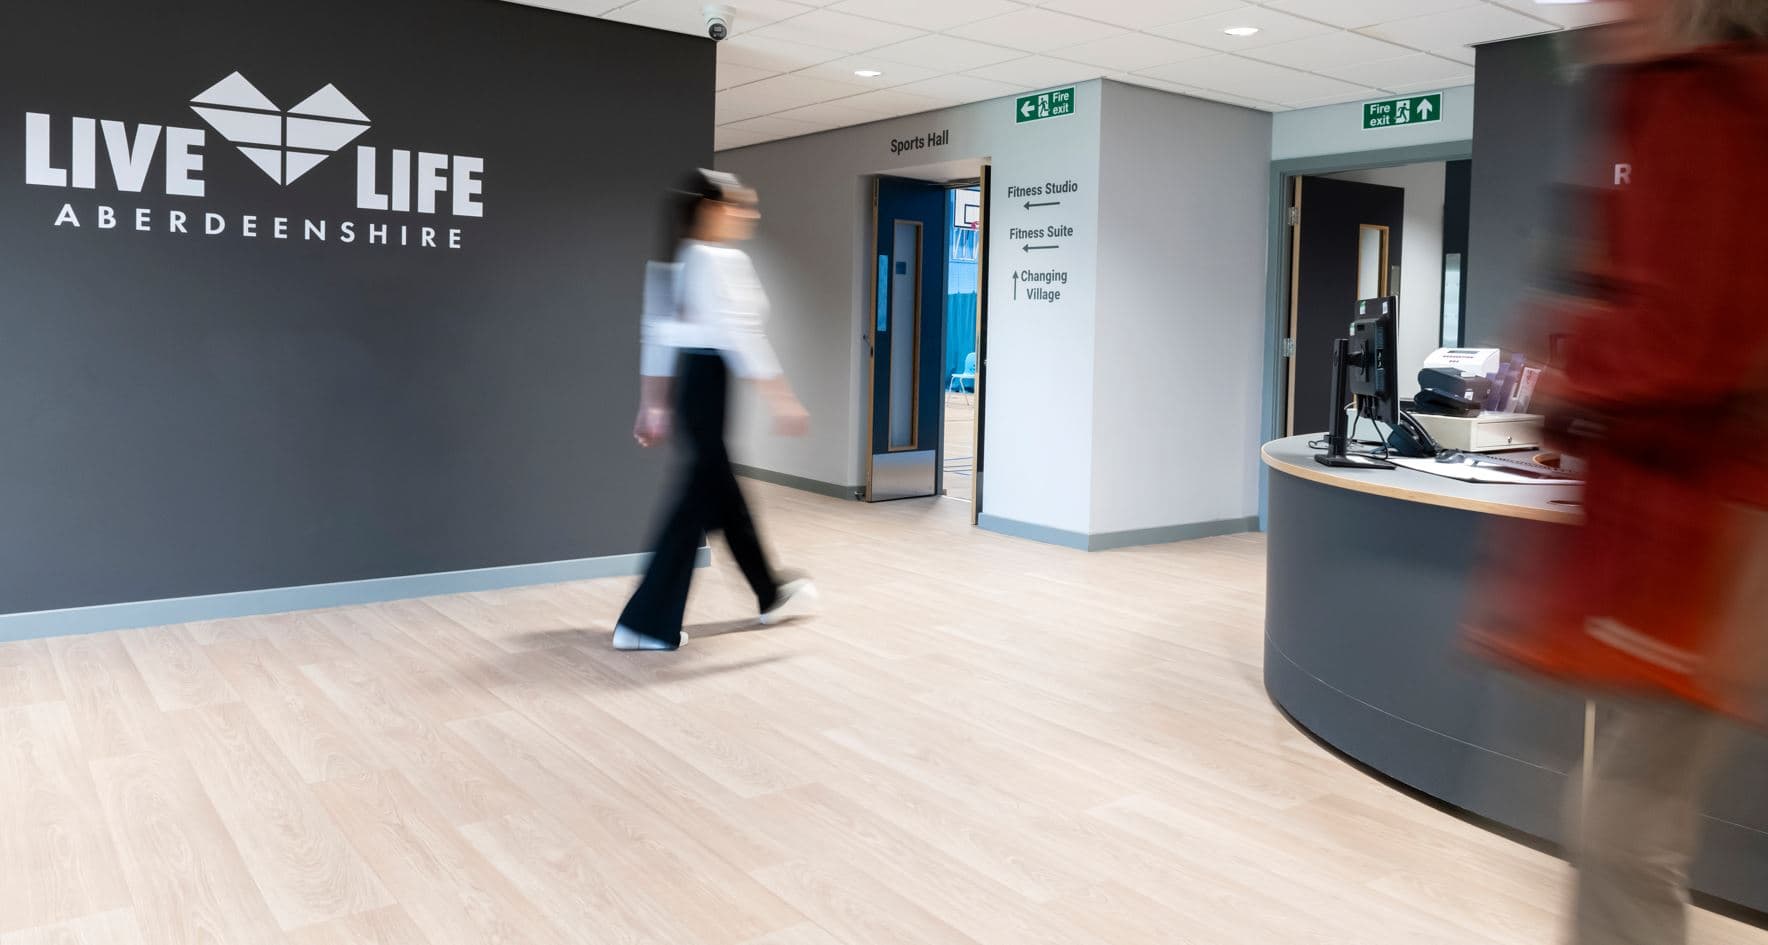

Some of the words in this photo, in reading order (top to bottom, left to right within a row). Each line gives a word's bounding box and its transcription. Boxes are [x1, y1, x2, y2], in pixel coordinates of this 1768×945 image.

[1052, 92, 1070, 103] Fire
[1052, 103, 1069, 115] exit
[1369, 104, 1391, 115] Fire
[1369, 115, 1390, 126] exit
[890, 135, 924, 155] Sports
[928, 129, 949, 147] Hall
[26, 112, 205, 197] LIVE
[357, 145, 484, 218] LIFE
[1007, 186, 1042, 199] Fitness
[1045, 179, 1078, 195] Studio
[54, 203, 462, 249] ABERDEENSHIRE
[1009, 227, 1044, 240] Fitness
[1047, 224, 1074, 238] Suite
[1021, 269, 1068, 284] Changing
[1026, 288, 1061, 303] Village
